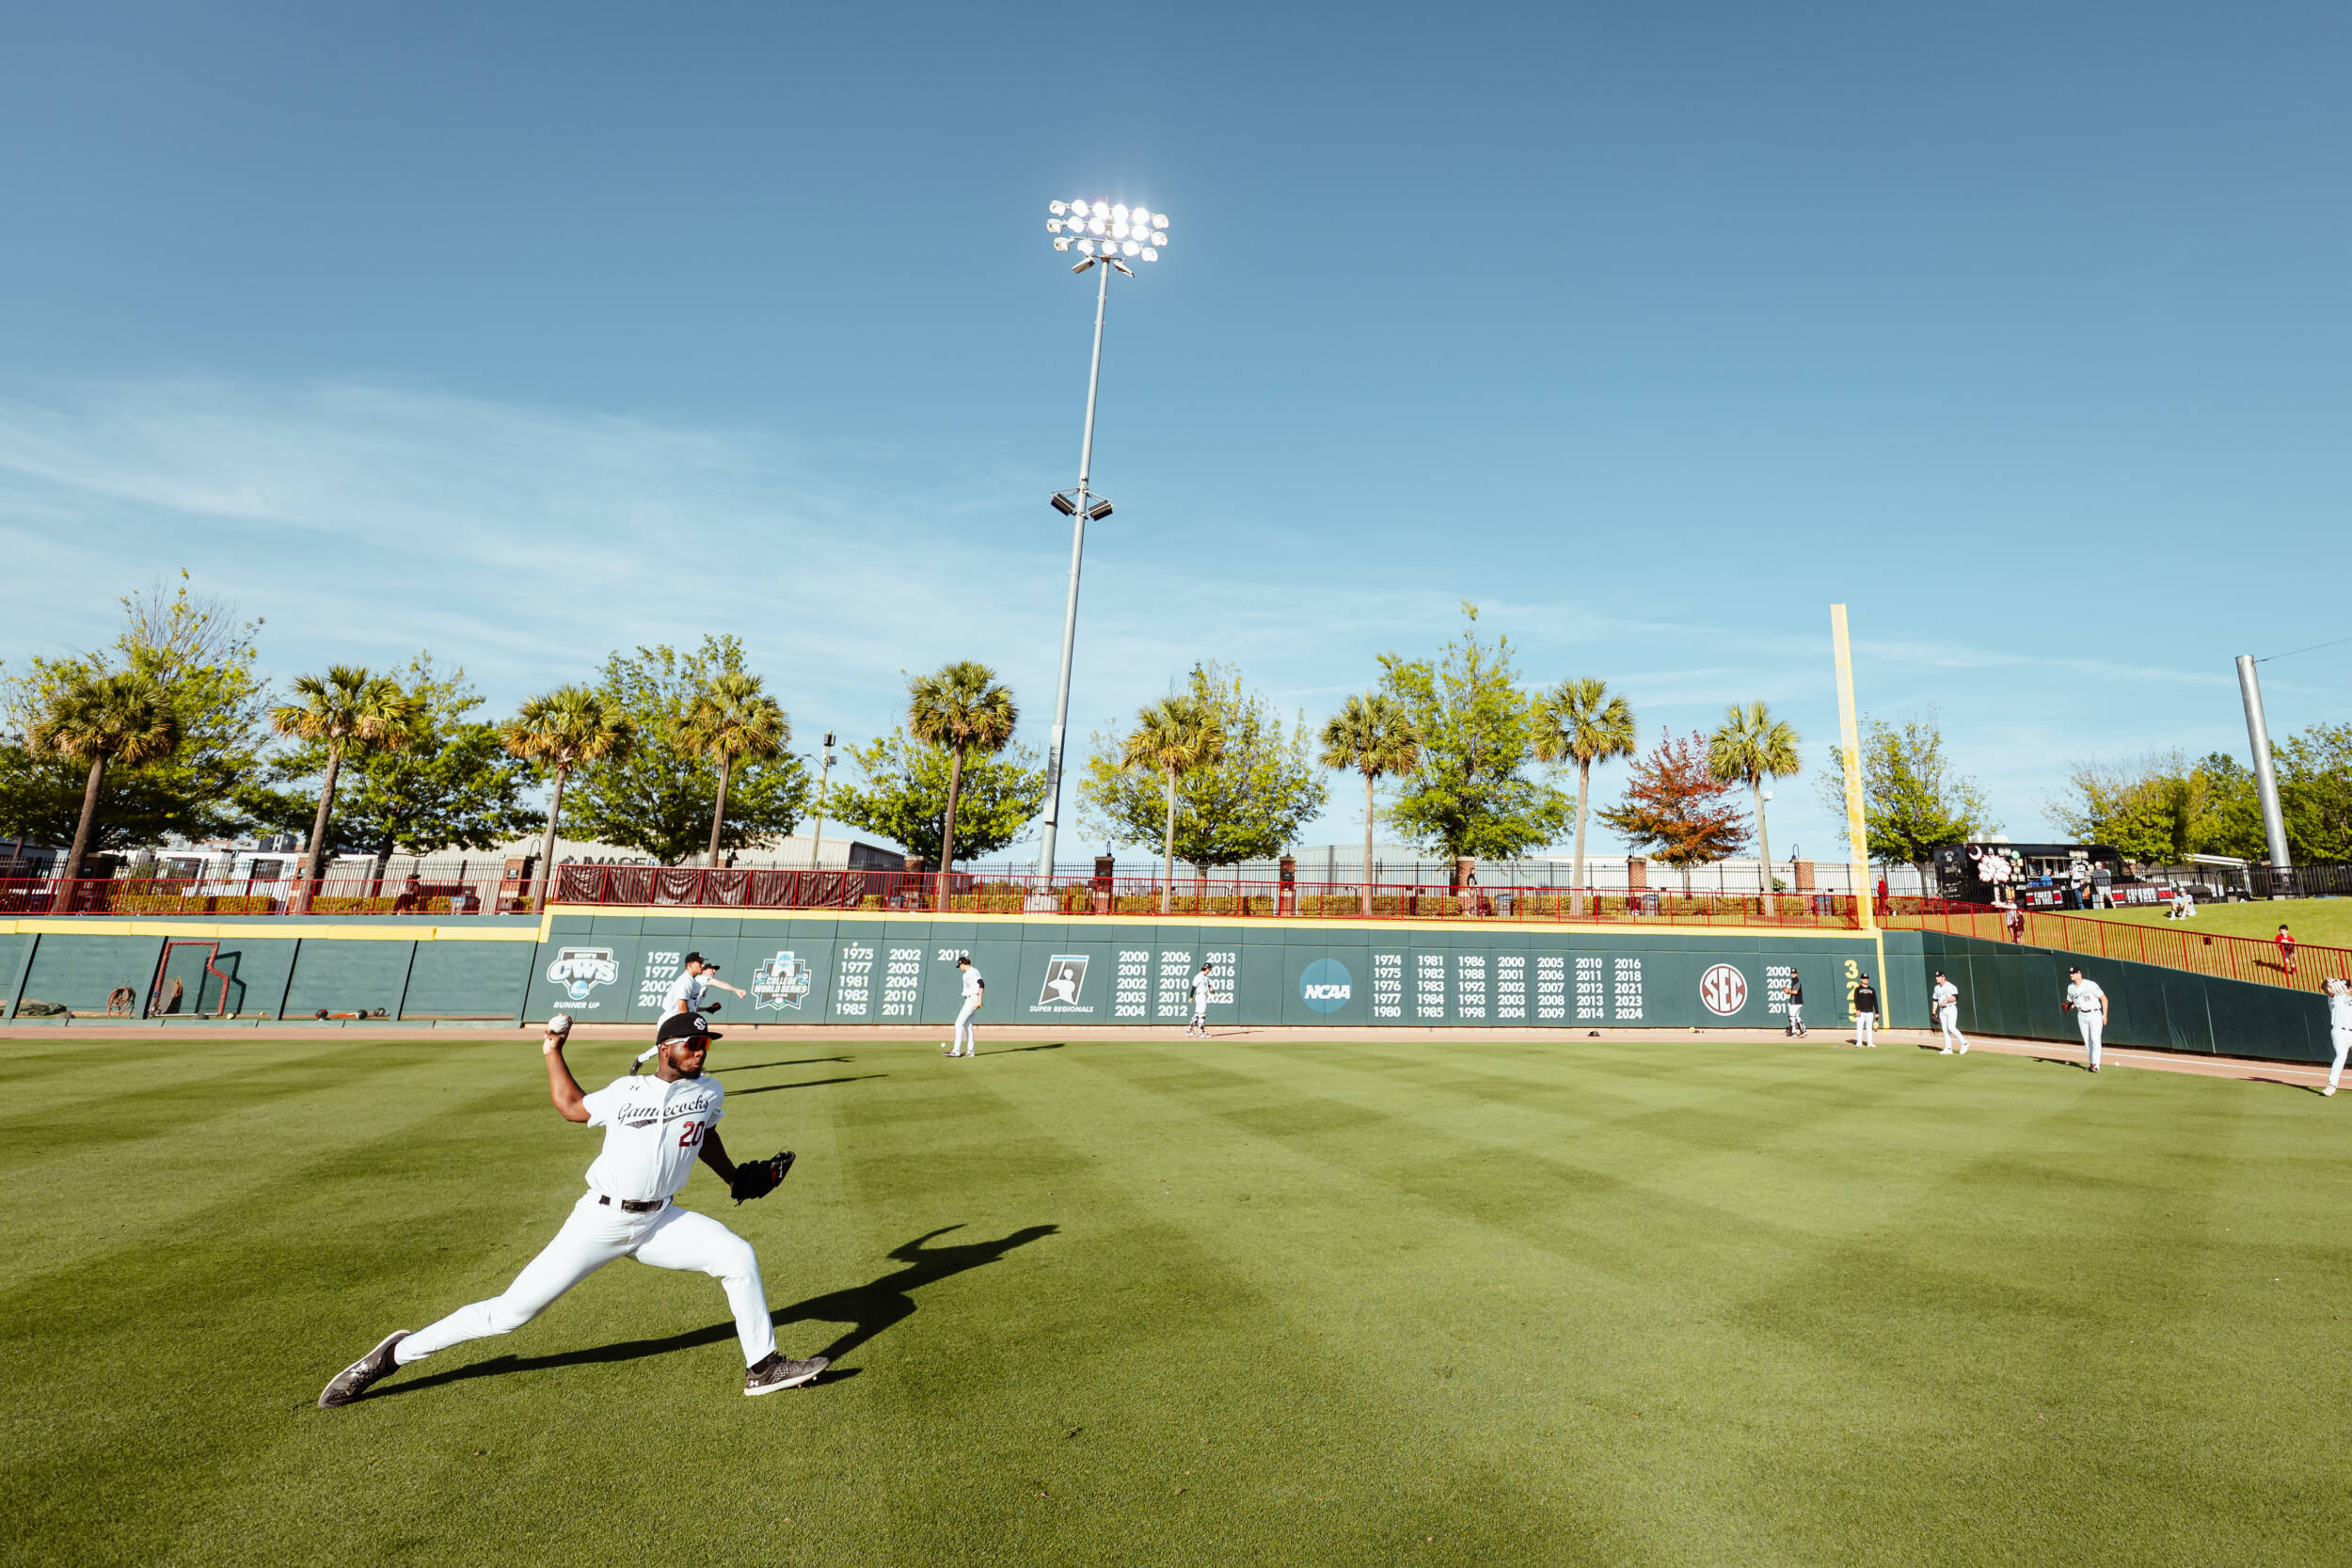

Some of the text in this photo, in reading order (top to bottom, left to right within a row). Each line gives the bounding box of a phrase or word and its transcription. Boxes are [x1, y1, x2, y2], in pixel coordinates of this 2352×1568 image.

[648, 952, 679, 964] 1975
[844, 948, 873, 959] 1975
[889, 949, 921, 960] 2002
[1120, 951, 1149, 962] 2000
[1162, 952, 1190, 962] 2006
[1206, 953, 1235, 963] 2013
[1375, 955, 1401, 965] 1974
[1418, 956, 1442, 966] 1981
[1458, 957, 1485, 966] 1986
[1498, 957, 1524, 967] 2000
[1537, 958, 1564, 968] 2005
[1576, 958, 1602, 968] 2010
[1615, 958, 1641, 969] 2016
[548, 959, 616, 982] CWS
[645, 966, 678, 978] 1977
[842, 962, 872, 973] 1977
[888, 962, 919, 974] 2003
[1119, 965, 1146, 975] 2001
[1161, 965, 1190, 975] 2007
[1375, 968, 1401, 978] 1975
[1418, 968, 1444, 978] 1982
[1766, 966, 1790, 976] 2000
[1458, 969, 1485, 979] 1988
[1498, 969, 1523, 979] 2001
[1538, 970, 1564, 980] 2006
[1577, 971, 1600, 980] 2011
[1615, 971, 1641, 981] 2018
[840, 975, 868, 987] 1981
[885, 976, 917, 988] 2004
[1118, 978, 1147, 989] 2002
[1160, 978, 1189, 989] 2010
[1375, 981, 1401, 990] 1976
[1418, 981, 1444, 991] 1983
[1458, 982, 1485, 991] 1992
[1304, 985, 1351, 1000] NCAA
[1498, 982, 1525, 992] 2002
[1538, 983, 1565, 992] 2007
[1577, 983, 1603, 993] 2012
[1614, 983, 1642, 993] 2021
[1702, 966, 1744, 1012] SEC
[638, 994, 662, 1006] 201
[838, 990, 868, 1001] 1982
[884, 990, 916, 1002] 2010
[1116, 991, 1146, 1003] 2003
[1159, 991, 1186, 1003] 2011
[1374, 993, 1401, 1004] 1977
[1418, 994, 1444, 1005] 1984
[1459, 994, 1486, 1005] 1993
[1498, 994, 1525, 1005] 2003
[1538, 995, 1565, 1006] 2008
[1577, 995, 1603, 1006] 2013
[1615, 995, 1642, 1006] 2023
[836, 1004, 866, 1015] 1985
[882, 1004, 913, 1015] 2011
[1115, 1006, 1145, 1016] 2004
[1158, 1006, 1187, 1016] 2012
[1374, 1006, 1401, 1017] 1980
[1417, 1006, 1443, 1017] 1985
[1459, 1007, 1486, 1017] 1998
[1498, 1007, 1525, 1018] 2004
[1538, 1007, 1565, 1018] 2009
[1577, 1007, 1604, 1018] 2014
[1615, 1008, 1643, 1019] 2024
[618, 1095, 709, 1125] Gamecocks
[679, 1121, 706, 1147] 20
